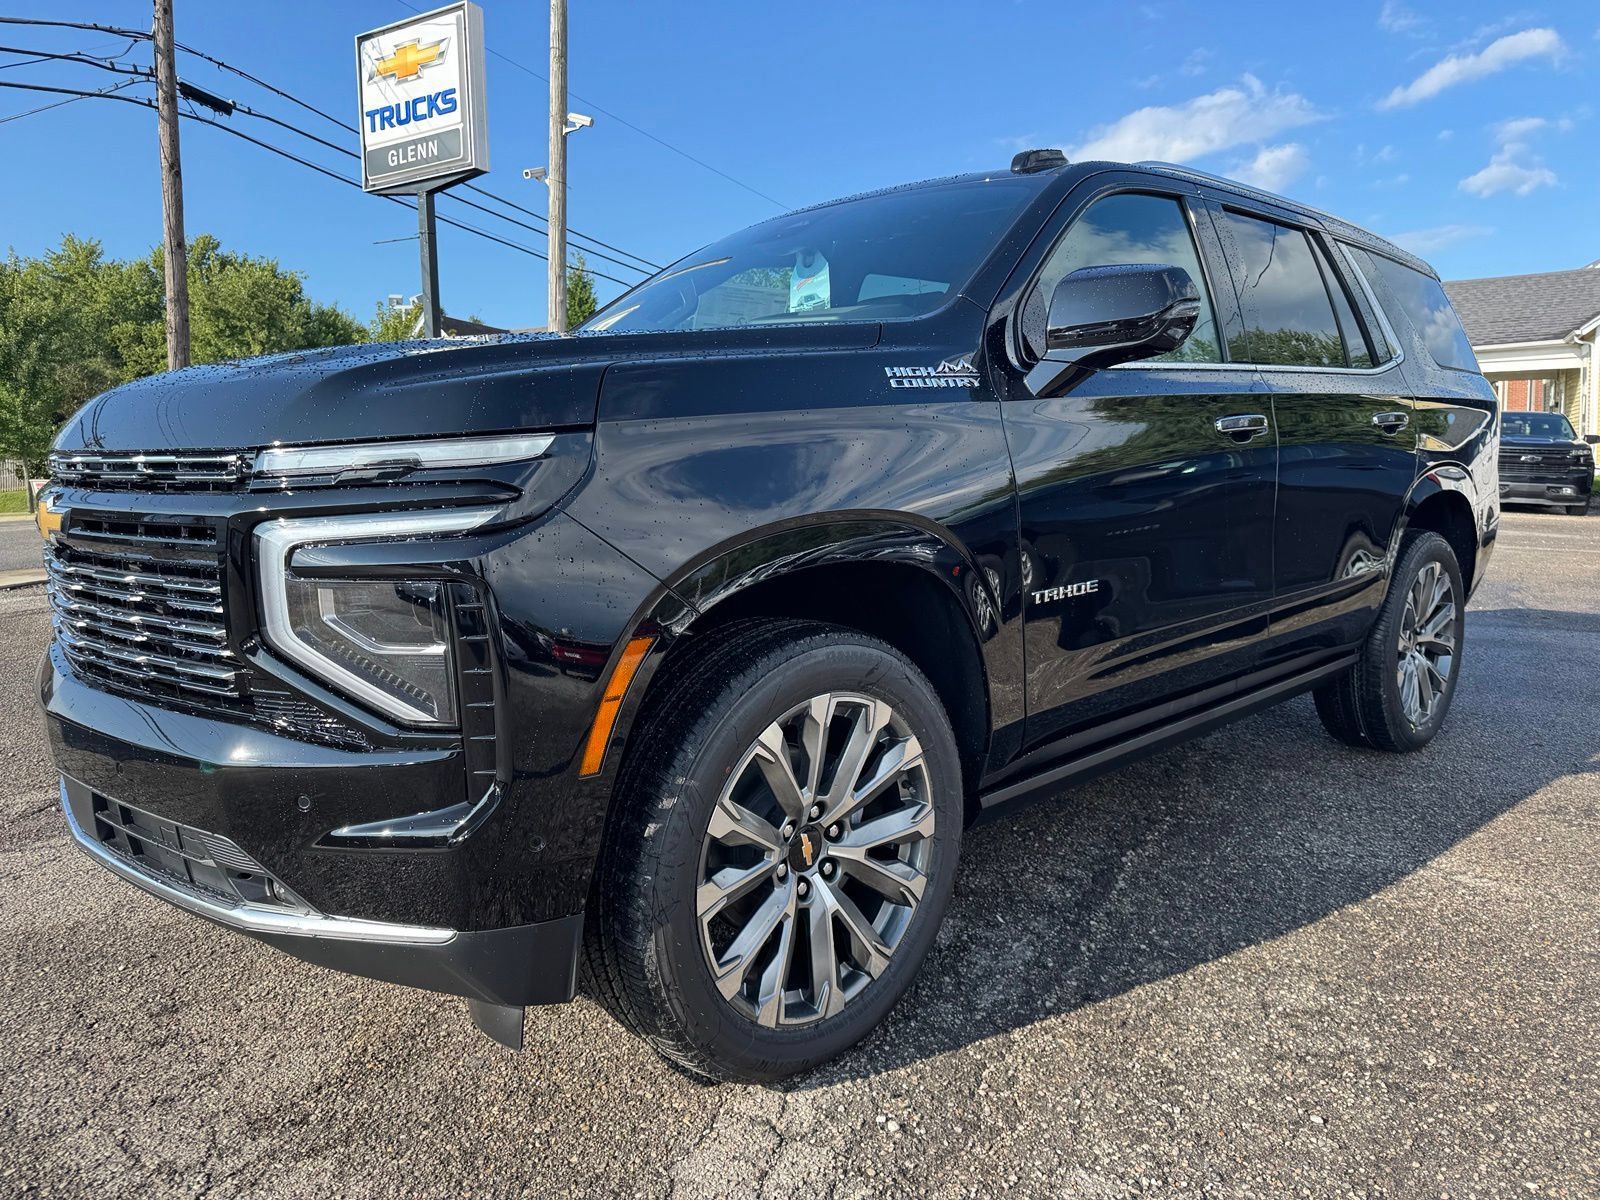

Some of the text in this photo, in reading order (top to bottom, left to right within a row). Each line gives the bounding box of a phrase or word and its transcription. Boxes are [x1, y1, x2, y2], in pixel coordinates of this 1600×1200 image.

[365, 87, 458, 133] TRUCKS
[387, 139, 439, 167] GLENN
[884, 366, 937, 377] HIGH
[889, 377, 981, 388] COUNTRY
[1031, 579, 1099, 605] TAHOE
